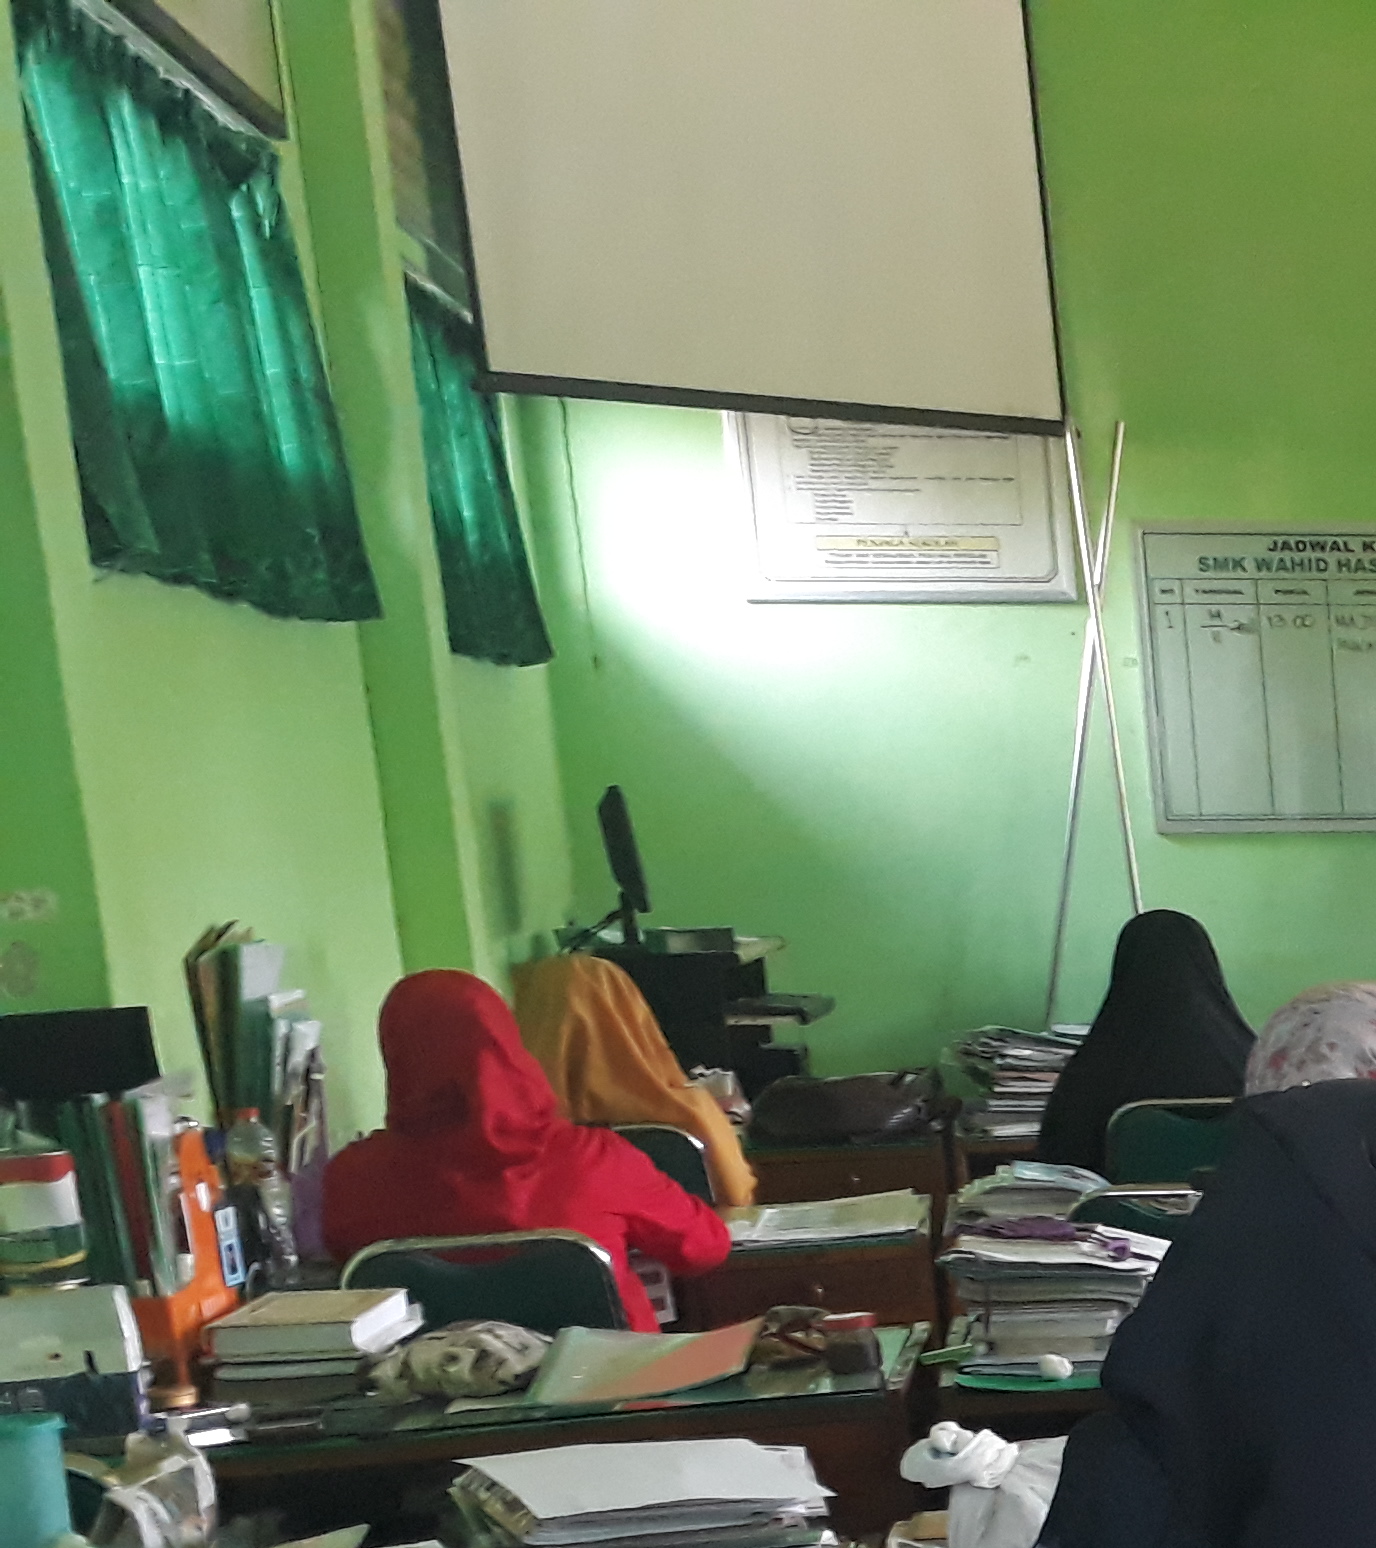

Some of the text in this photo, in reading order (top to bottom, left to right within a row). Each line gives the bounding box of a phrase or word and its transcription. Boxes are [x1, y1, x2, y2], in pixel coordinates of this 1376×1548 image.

[1267, 538, 1355, 553] JADWAL
[1198, 556, 1249, 573] SMK
[1254, 556, 1329, 574] WAHID
